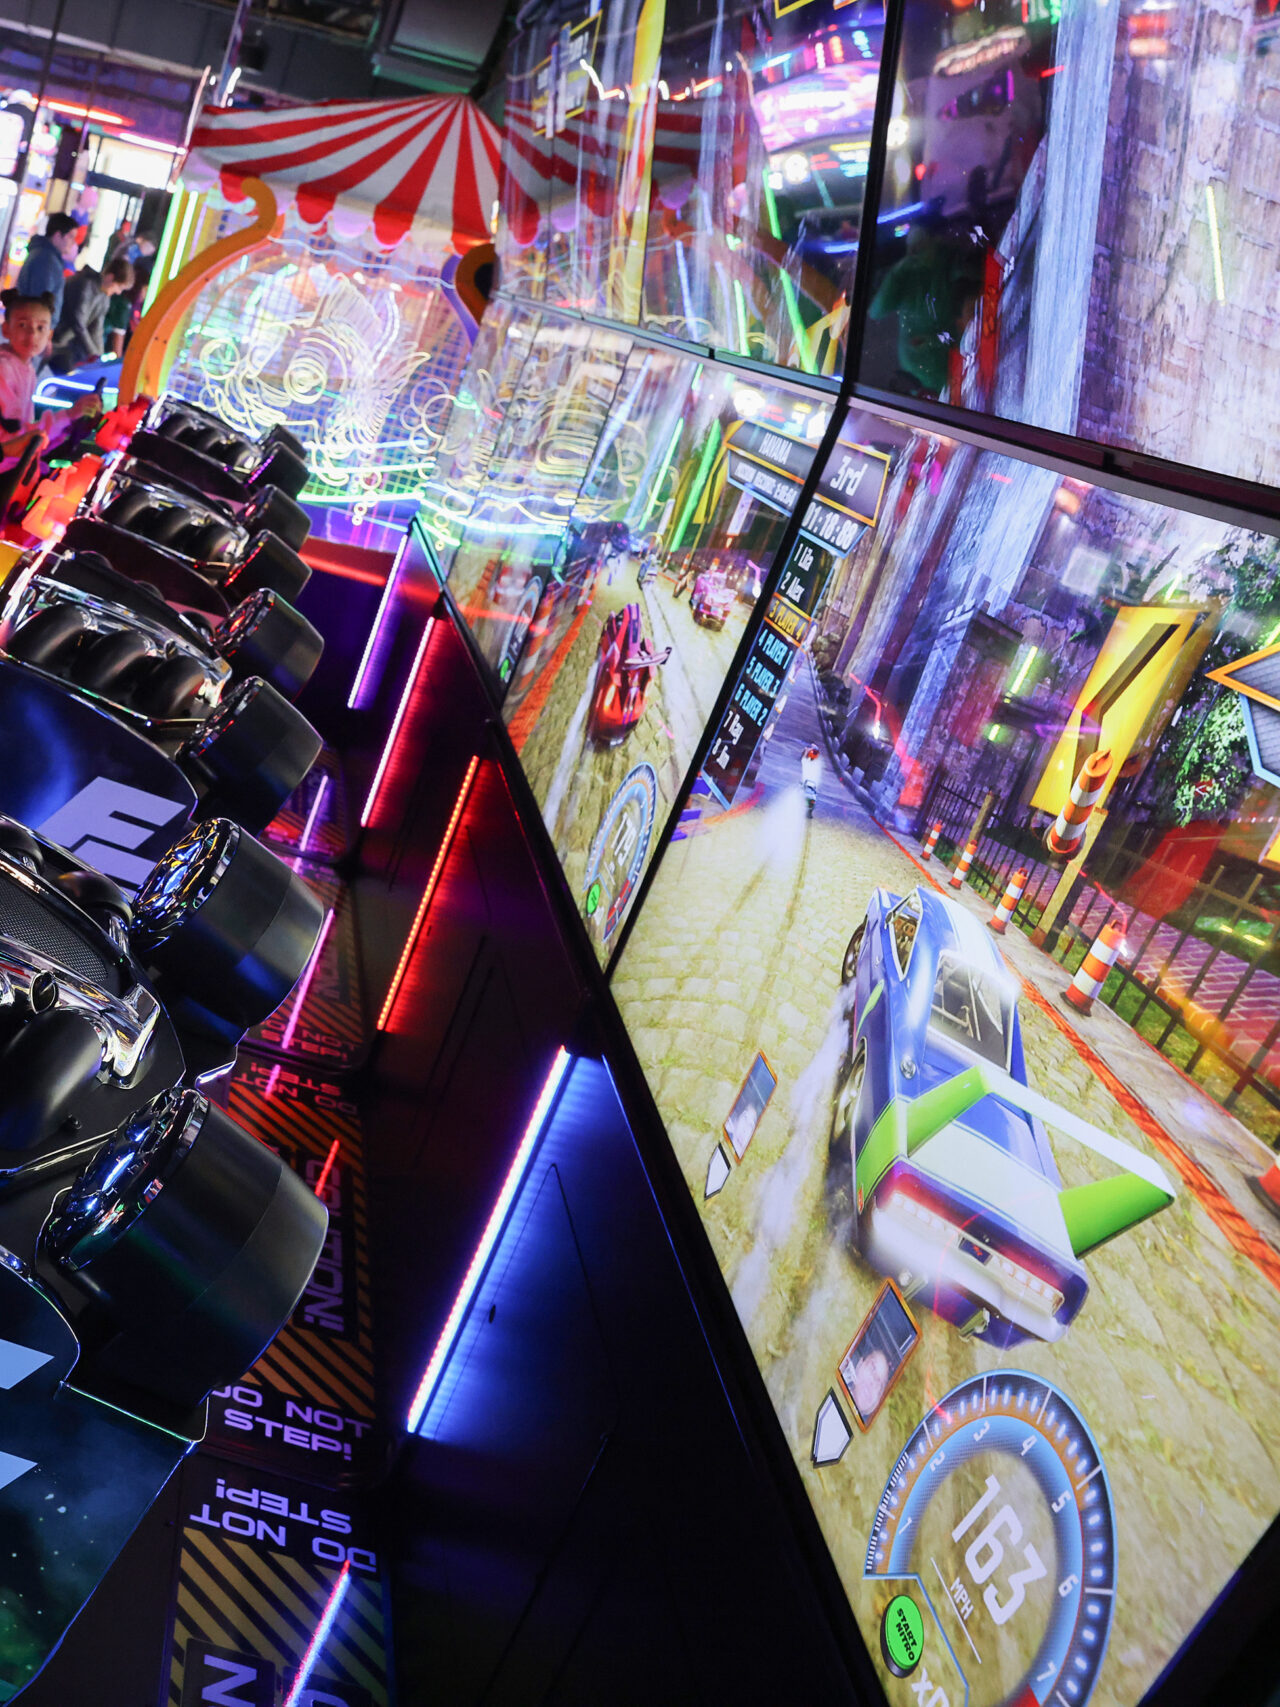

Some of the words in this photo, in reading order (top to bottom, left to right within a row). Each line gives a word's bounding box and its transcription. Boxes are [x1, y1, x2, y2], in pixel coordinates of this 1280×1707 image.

[759, 432, 793, 465] HAVANA
[830, 455, 868, 496] 3rd
[794, 543, 803, 561] 1
[781, 571, 791, 590] 2
[769, 600, 780, 618] 3
[774, 604, 799, 636] PLAYER
[759, 629, 768, 646] 4
[796, 621, 807, 640] 4
[762, 633, 788, 666] PLAYER
[783, 650, 793, 670] 1
[746, 656, 757, 674] 5
[750, 662, 775, 693] PLAYER
[769, 679, 780, 698] 3
[735, 683, 745, 701] 6
[740, 689, 763, 721] PLAYER
[757, 707, 768, 726] 2
[723, 710, 733, 728] 7
[286, 1400, 372, 1439] NOT
[973, 1421, 991, 1442] 3
[224, 1408, 352, 1461] STEP!
[1021, 1435, 1038, 1456] 4
[930, 1451, 946, 1472] 2
[215, 1478, 352, 1534] STEP!
[1051, 1490, 1071, 1512] 5
[189, 1503, 286, 1547] NOT
[898, 1517, 913, 1535] 1
[312, 1537, 377, 1573] DO
[951, 1474, 1048, 1626] 163
[1058, 1574, 1079, 1598] 6
[950, 1577, 974, 1620] MPH
[897, 1608, 917, 1647] START
[896, 1622, 915, 1661] NITRO
[1036, 1661, 1057, 1682] 7
